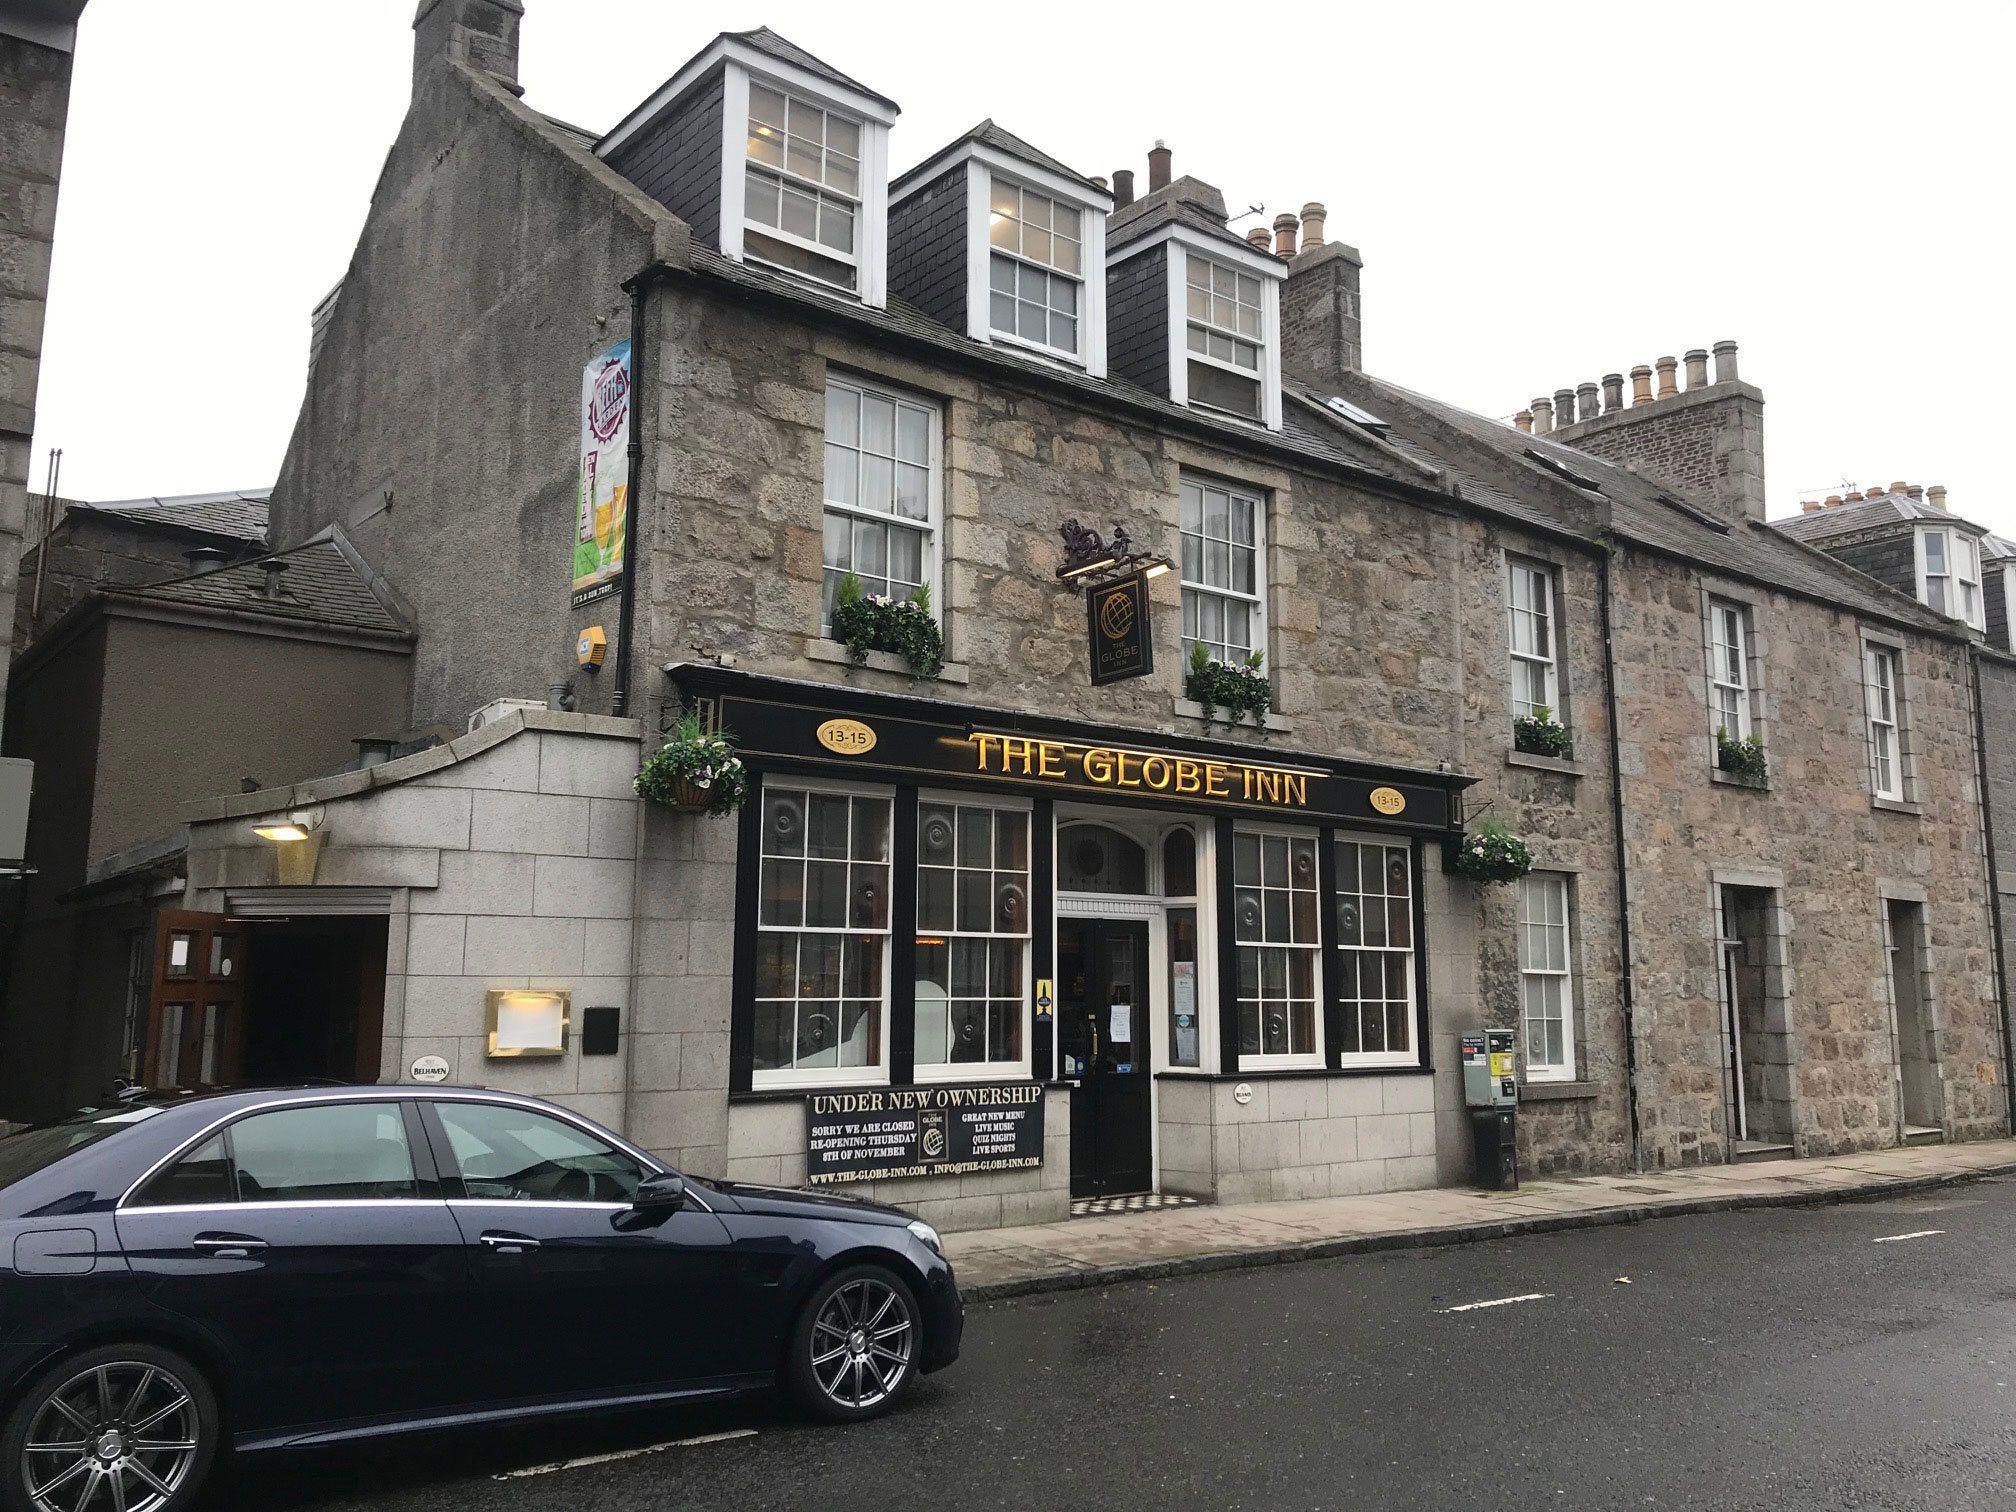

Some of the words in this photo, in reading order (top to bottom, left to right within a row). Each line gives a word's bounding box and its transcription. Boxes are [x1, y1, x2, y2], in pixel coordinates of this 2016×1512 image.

[1101, 645, 1139, 663] GLOBE
[828, 730, 867, 744] 13-15
[968, 733, 1067, 779] THE
[1083, 749, 1230, 798] GLOBE
[1243, 768, 1307, 806] INN
[1376, 796, 1400, 807] 13-15
[413, 1067, 446, 1076] BELHAVEN
[813, 1093, 884, 1115] UNDER
[888, 1090, 932, 1110] NEW
[936, 1086, 1041, 1108] OWNERSHIP
[961, 1113, 987, 1123] GREAT
[988, 1112, 1004, 1121] NEW
[1005, 1111, 1026, 1120] MENU
[811, 1125, 843, 1137] SORRY
[844, 1124, 860, 1135] WE
[861, 1123, 881, 1134] ARE
[881, 1120, 915, 1132] CLOSED
[975, 1123, 993, 1133] LIVE
[993, 1122, 1015, 1132] MUSIC
[810, 1136, 867, 1150] RE-OPENING
[867, 1133, 917, 1146] THURSDAY
[972, 1134, 990, 1145] QUIZ
[990, 1132, 1016, 1143] NIGHTS
[822, 1150, 840, 1162] 8TH
[840, 1149, 854, 1160] OF
[854, 1146, 905, 1160] NOVEMBER
[972, 1145, 990, 1155] LIVE
[990, 1143, 1016, 1154] SPORTS
[810, 1165, 927, 1185] WWW.THE-GLOBE-INN.COM
[934, 1157, 1040, 1175] INFO@THE-GLOBE-INN.COM
